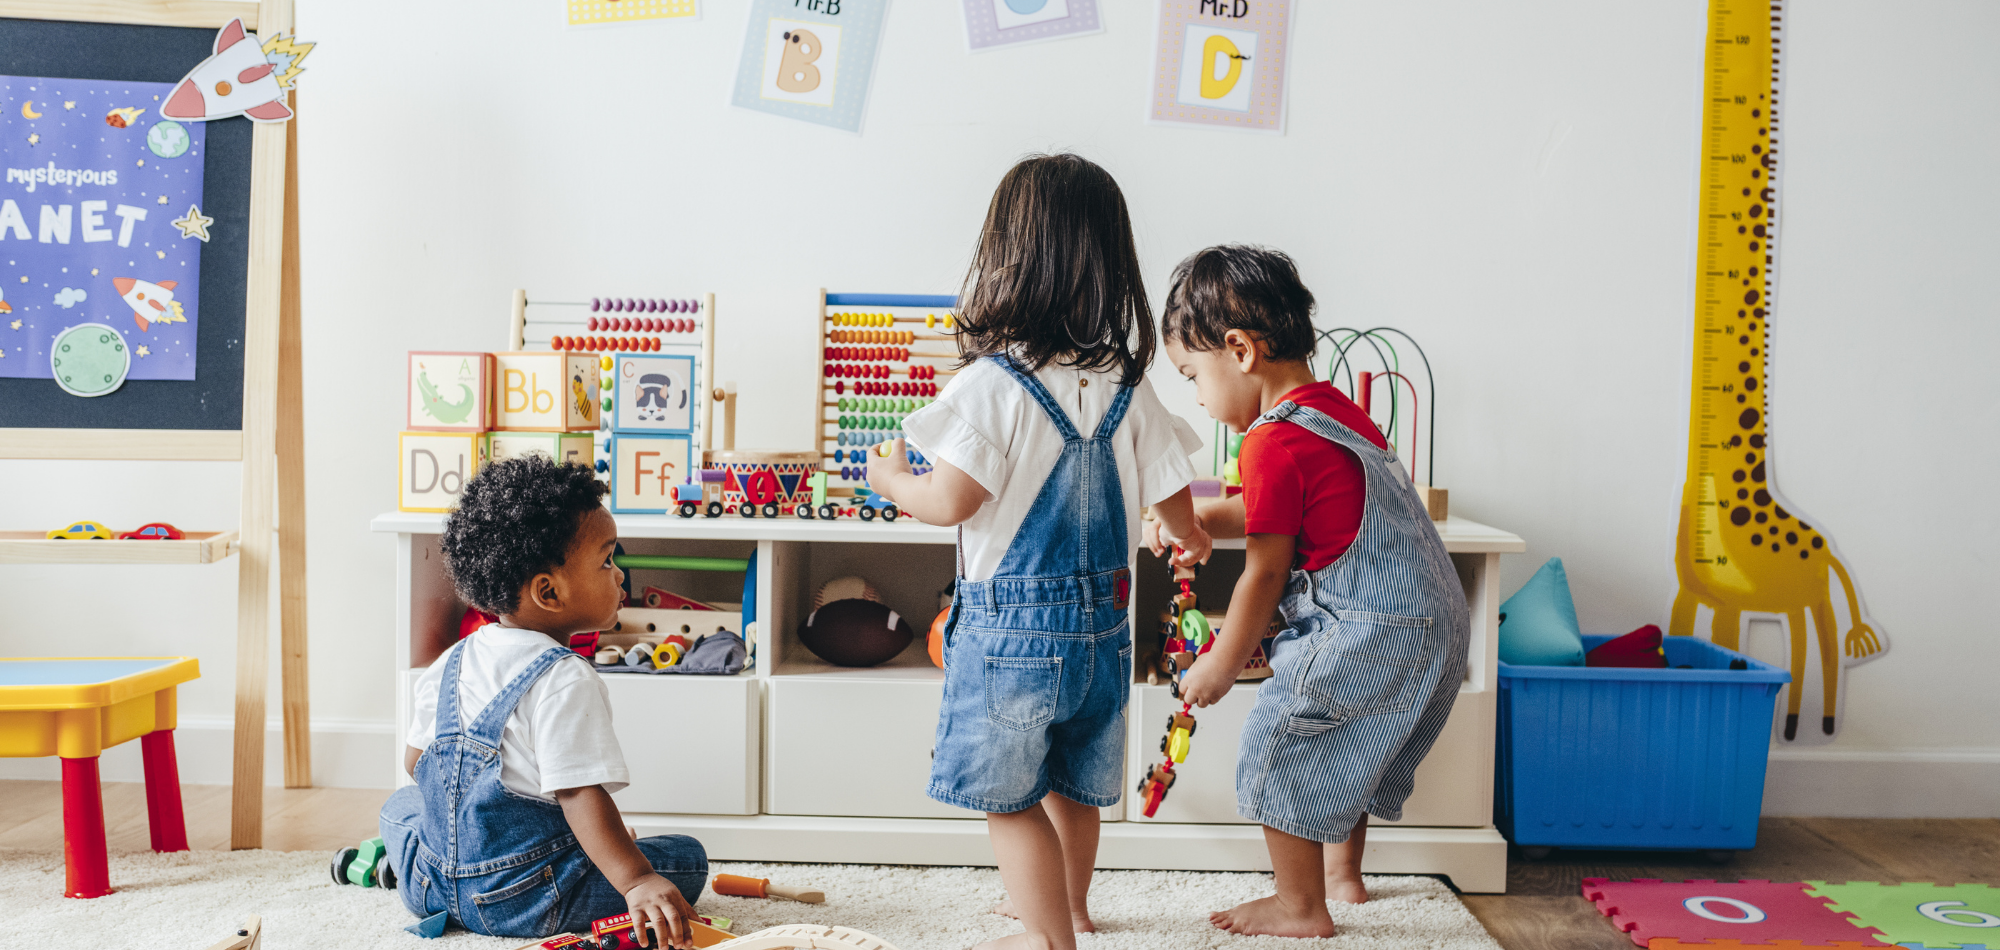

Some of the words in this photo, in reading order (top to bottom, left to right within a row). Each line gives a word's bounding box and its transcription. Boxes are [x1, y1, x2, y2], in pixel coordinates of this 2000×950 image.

[6, 161, 118, 193] mysterious
[458, 357, 471, 375] A
[622, 361, 635, 378] C
[504, 369, 554, 414] Bb
[493, 440, 501, 457] E
[410, 449, 464, 494] Dd
[634, 451, 675, 496] Ff
[1916, 901, 2000, 928] 6
